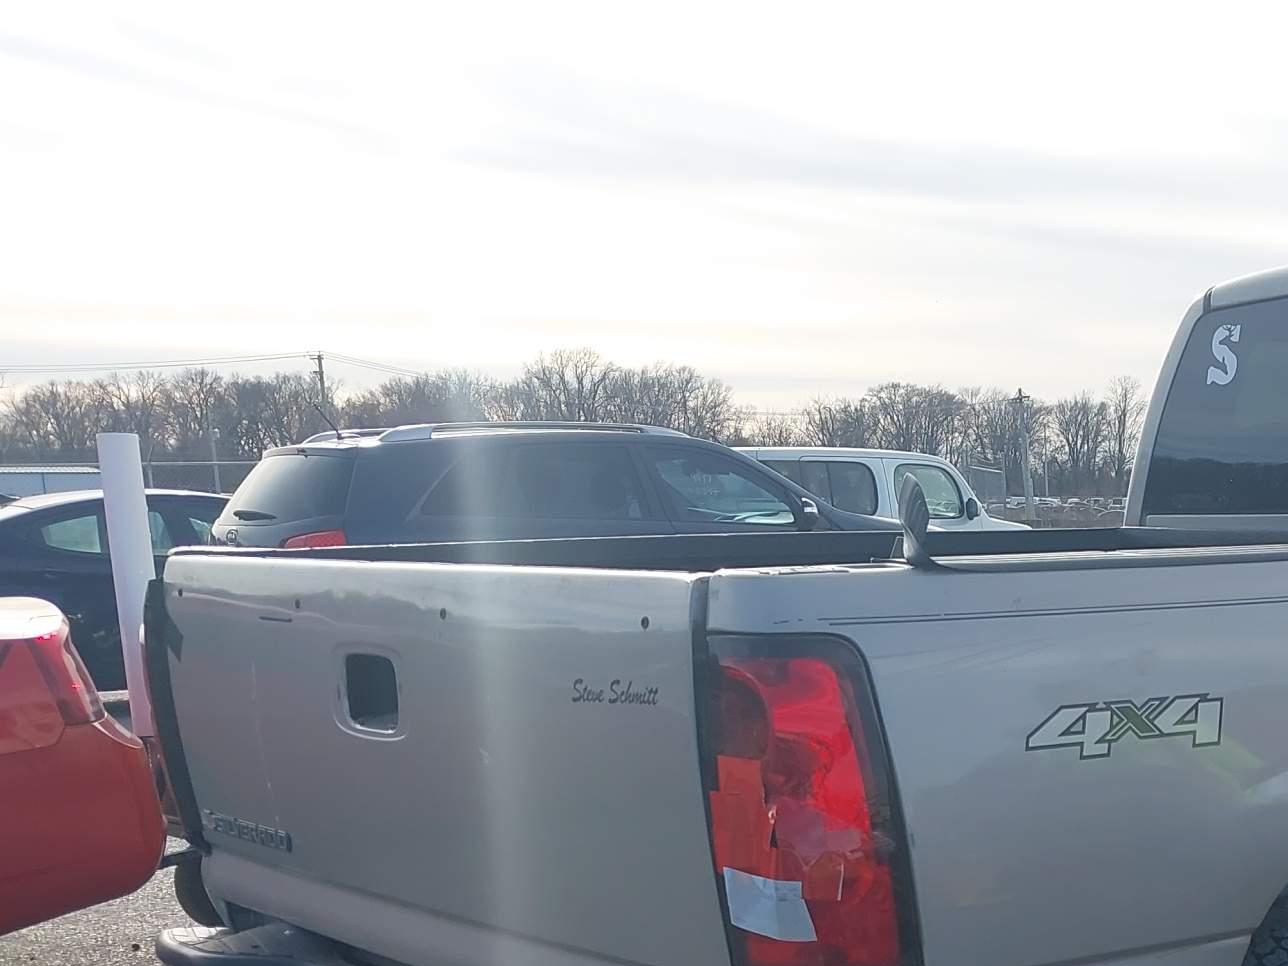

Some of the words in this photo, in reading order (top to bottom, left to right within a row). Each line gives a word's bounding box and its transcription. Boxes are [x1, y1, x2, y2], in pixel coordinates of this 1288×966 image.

[1206, 325, 1241, 385] S
[571, 678, 605, 703] Steve
[607, 679, 659, 706] Schmitt
